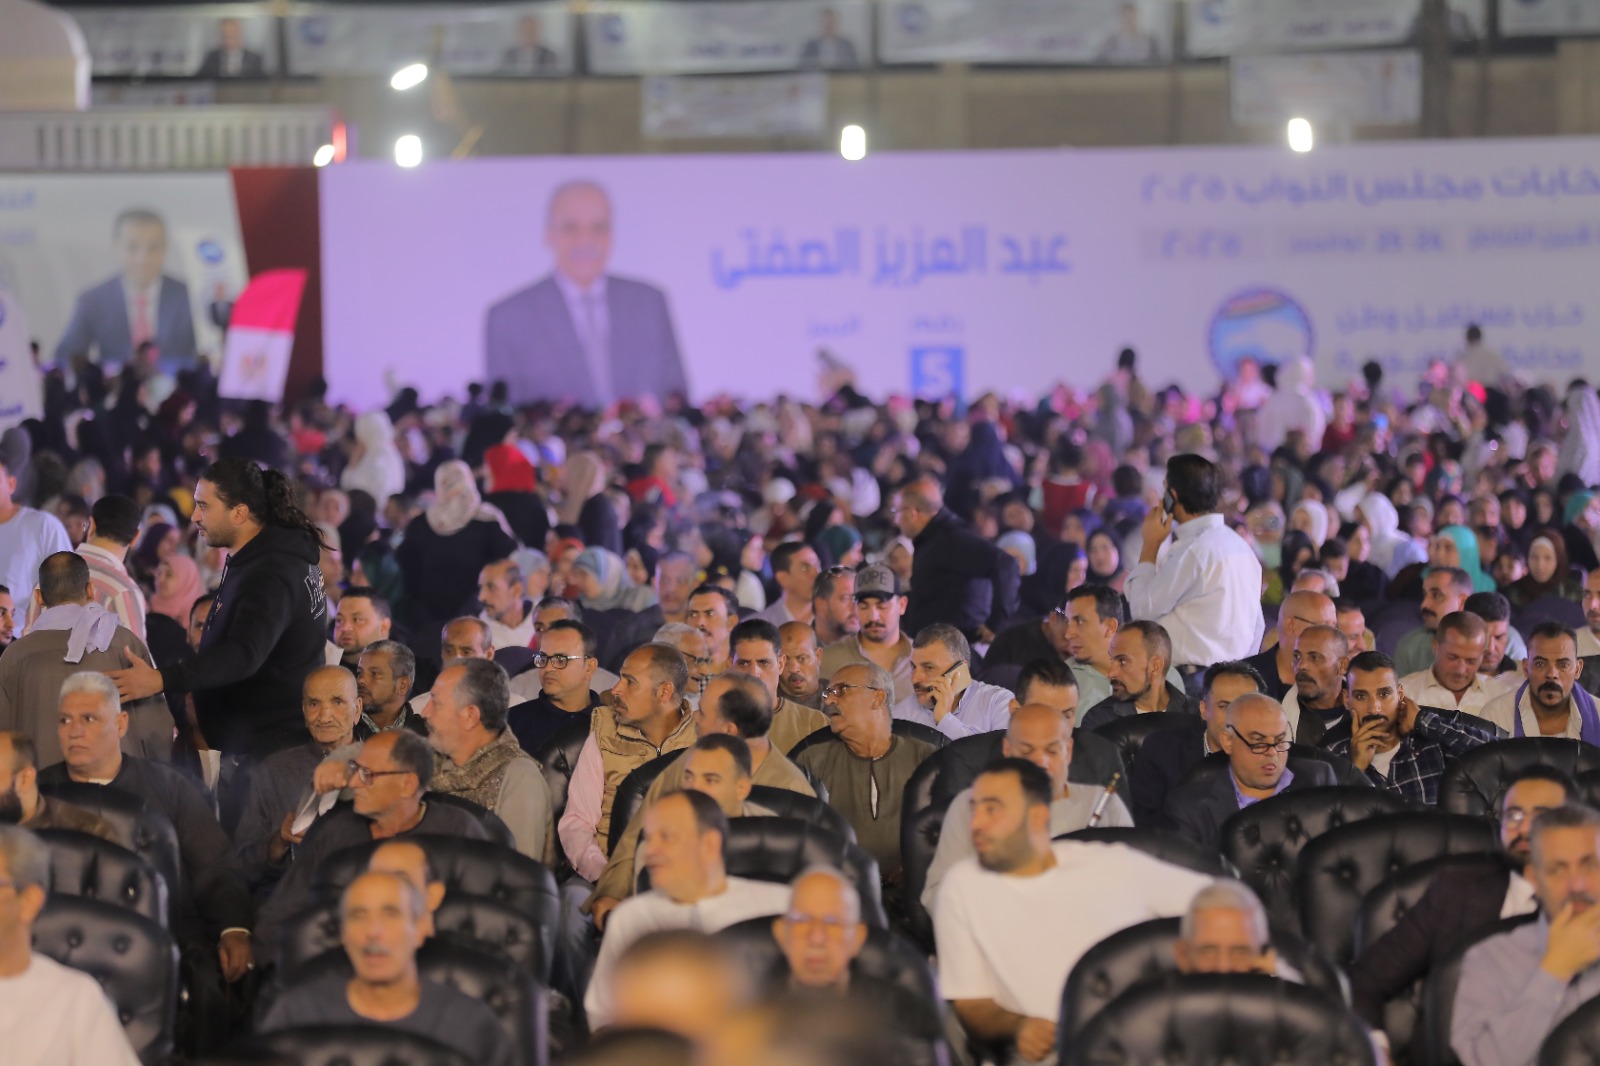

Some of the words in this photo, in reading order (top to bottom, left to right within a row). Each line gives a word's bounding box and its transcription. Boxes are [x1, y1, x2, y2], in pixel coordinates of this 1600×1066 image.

[1354, 168, 1484, 207] مجلس
[871, 225, 987, 288] العزيز
[1001, 233, 1072, 286] عبد
